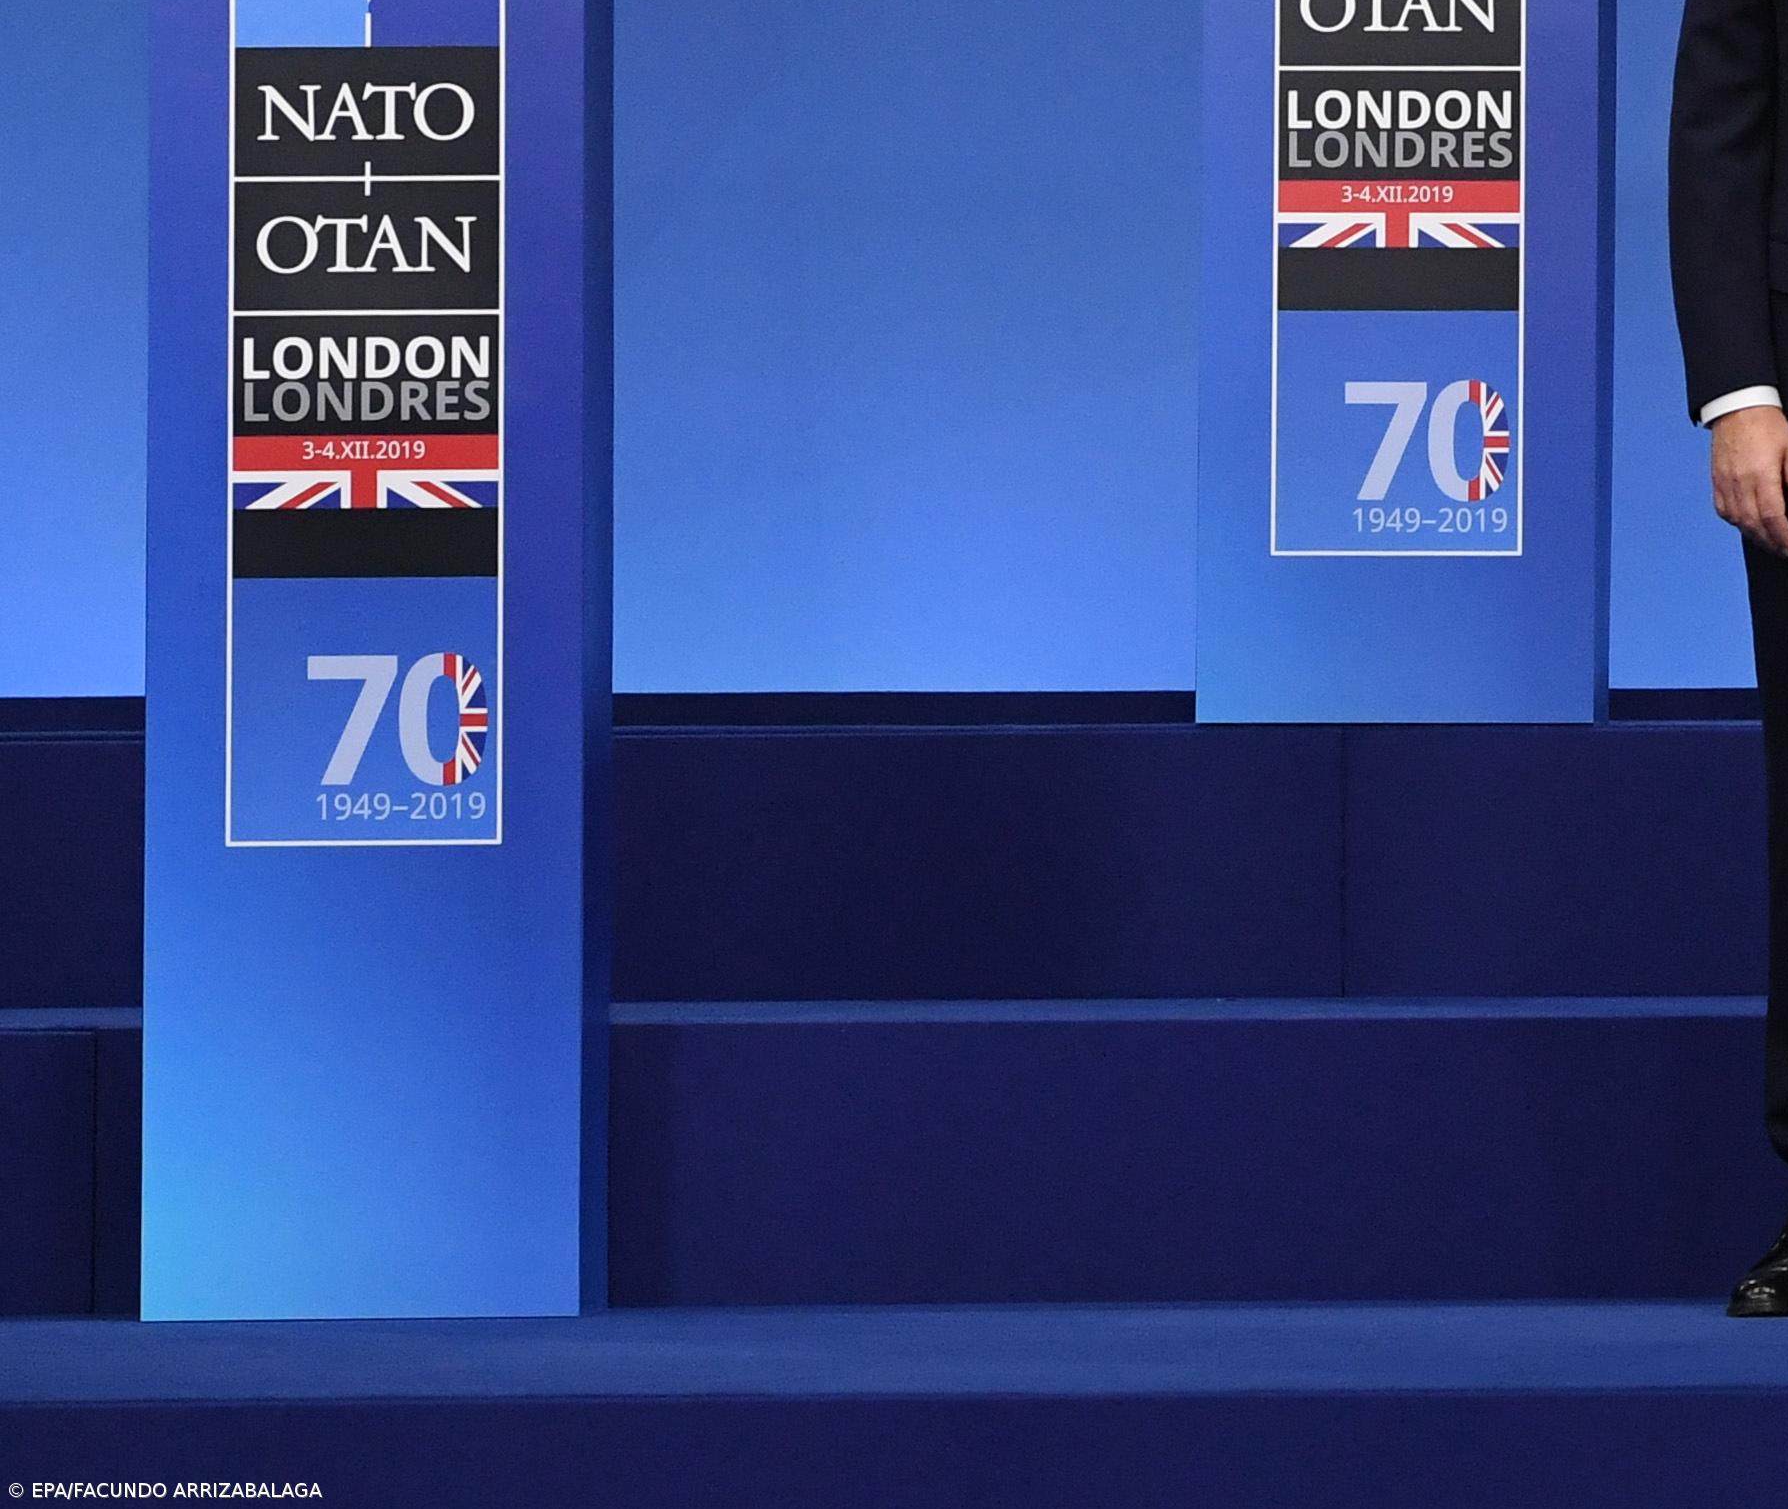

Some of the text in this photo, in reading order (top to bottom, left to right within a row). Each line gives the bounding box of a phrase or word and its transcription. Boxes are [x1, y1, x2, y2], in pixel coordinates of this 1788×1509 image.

[258, 82, 474, 141] NATO
[1288, 90, 1511, 129] LONDON
[1289, 132, 1512, 167] LONDRES
[1342, 186, 1453, 202] 3-4.XII.2019
[257, 215, 476, 273] OTAN
[244, 336, 489, 379] LONDON
[245, 381, 490, 421] LONDRES
[303, 441, 425, 459] 3-4.XII.2019
[1345, 379, 1510, 501] 70
[308, 653, 488, 786] 70
